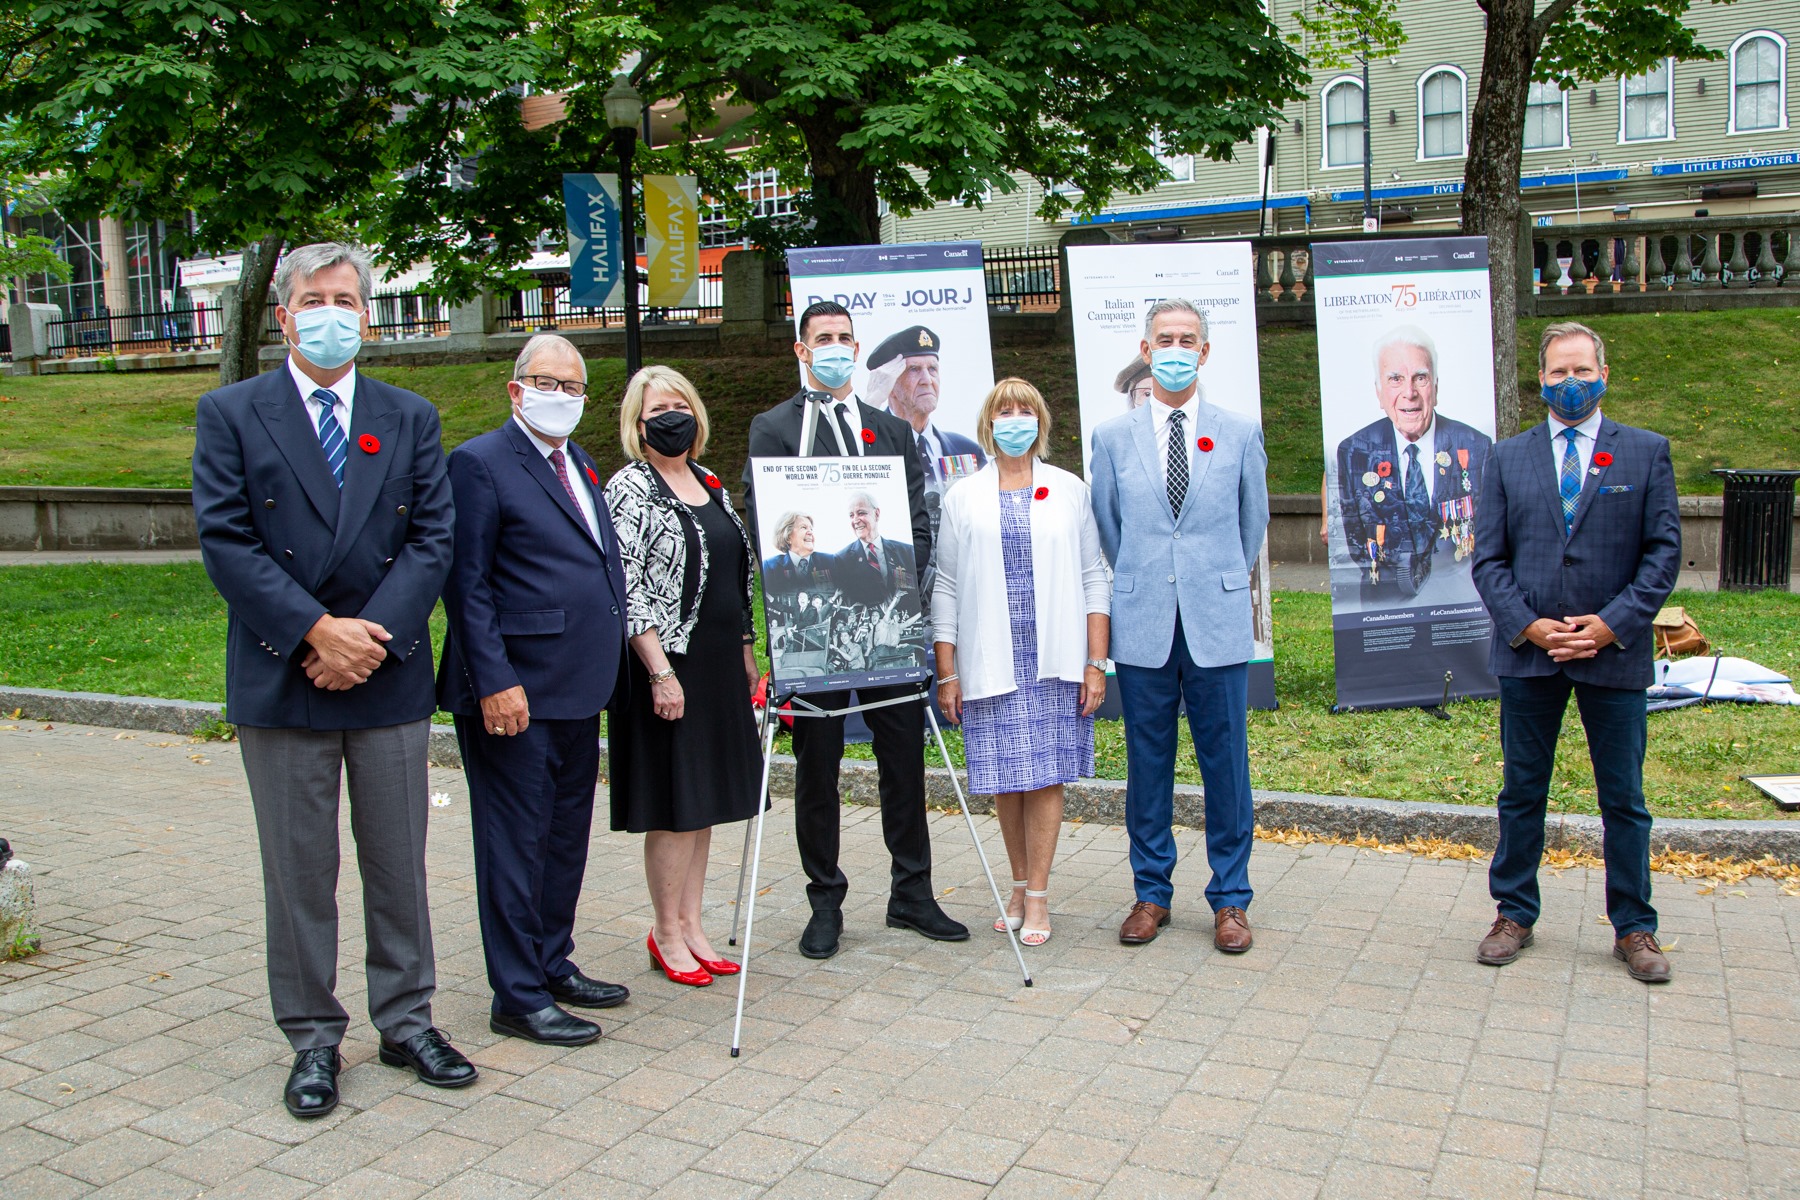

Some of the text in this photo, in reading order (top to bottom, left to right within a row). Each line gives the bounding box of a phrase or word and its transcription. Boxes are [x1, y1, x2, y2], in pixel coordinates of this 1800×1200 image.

[1682, 162, 1718, 173] LITTLE
[1721, 159, 1746, 169] FISH
[1749, 154, 1793, 167] OYSTER
[1433, 184, 1455, 194] FIVE
[1538, 216, 1553, 226] 1740
[588, 193, 609, 282] HALIFAX
[667, 195, 686, 283] HALIFAX
[943, 249, 969, 258] Canada
[1453, 251, 1475, 260] Canada
[1216, 269, 1240, 277] Canada
[901, 287, 972, 307] JOUR J
[1324, 293, 1392, 307] LIBERATION
[1391, 284, 1417, 308] 75
[1418, 289, 1482, 302] LIBÉRATION
[1104, 299, 1135, 310] Italian
[1087, 310, 1136, 322] Campaign
[818, 463, 841, 483] 75
[864, 471, 890, 479] MONDIALE
[1362, 613, 1414, 622] #CanadaRemembers
